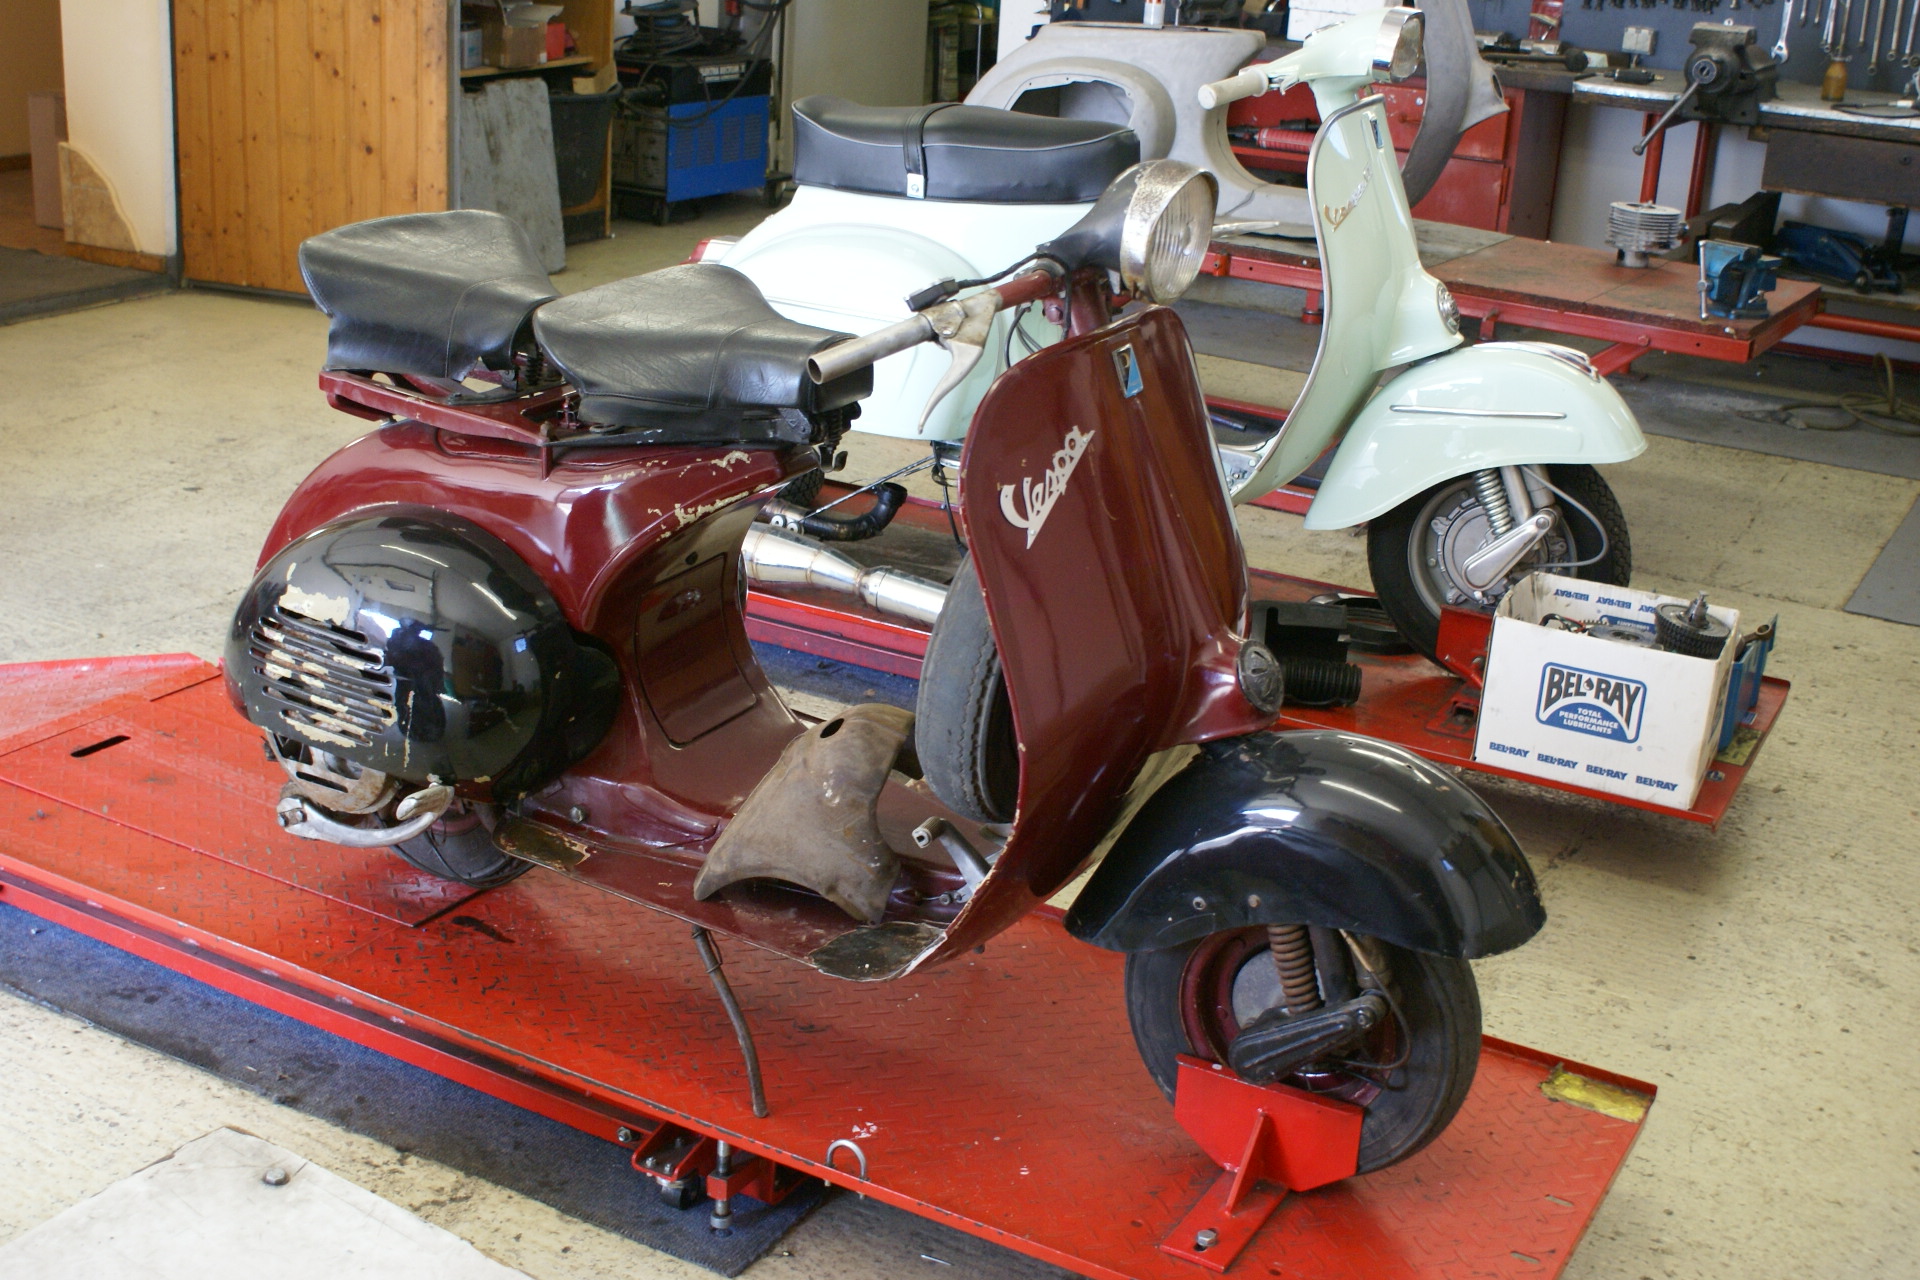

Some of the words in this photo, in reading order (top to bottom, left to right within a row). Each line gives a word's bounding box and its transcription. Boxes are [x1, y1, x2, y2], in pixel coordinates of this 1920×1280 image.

[999, 425, 1096, 550] Vespa
[1559, 710, 1619, 729] PERFORMANCE
[1577, 707, 1602, 718] TOTAL
[1563, 719, 1612, 735] LUBRICANTS
